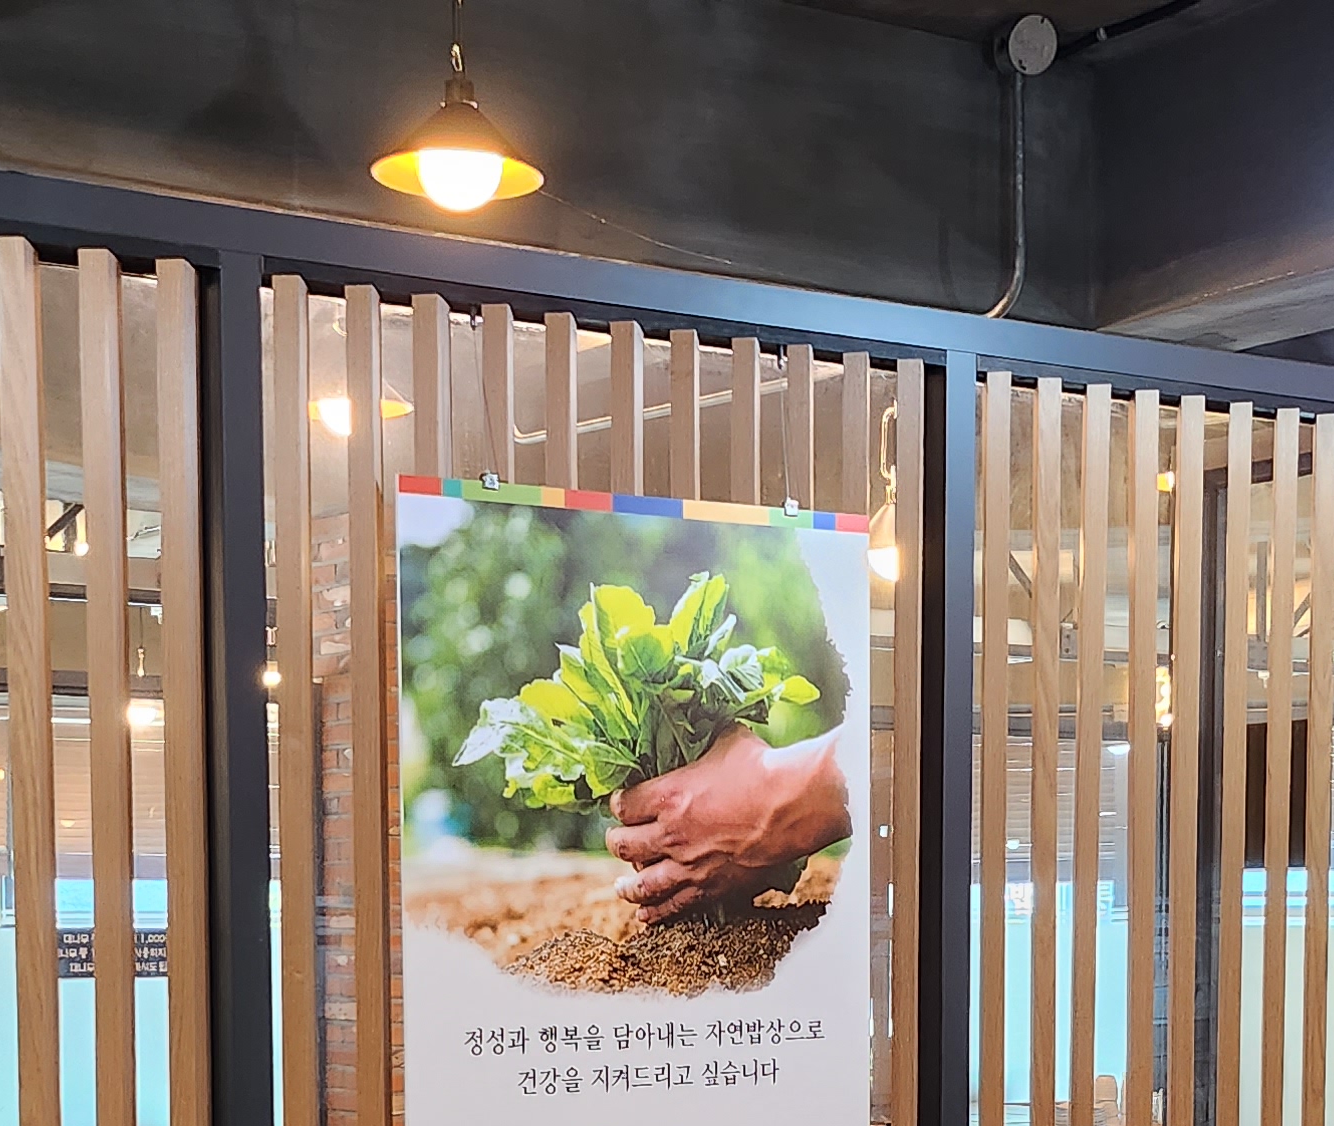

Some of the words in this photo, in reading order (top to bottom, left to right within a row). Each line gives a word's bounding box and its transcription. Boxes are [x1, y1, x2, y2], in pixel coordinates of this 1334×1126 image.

[464, 1026, 530, 1056] 정성과
[538, 1024, 606, 1053] 행복을
[612, 1021, 699, 1051] 담아내는
[705, 1018, 826, 1048] 자연밥상으로
[517, 1066, 584, 1096] 건강을
[590, 1061, 694, 1094] 지켜드리고
[700, 1057, 780, 1088] 싶습니다
